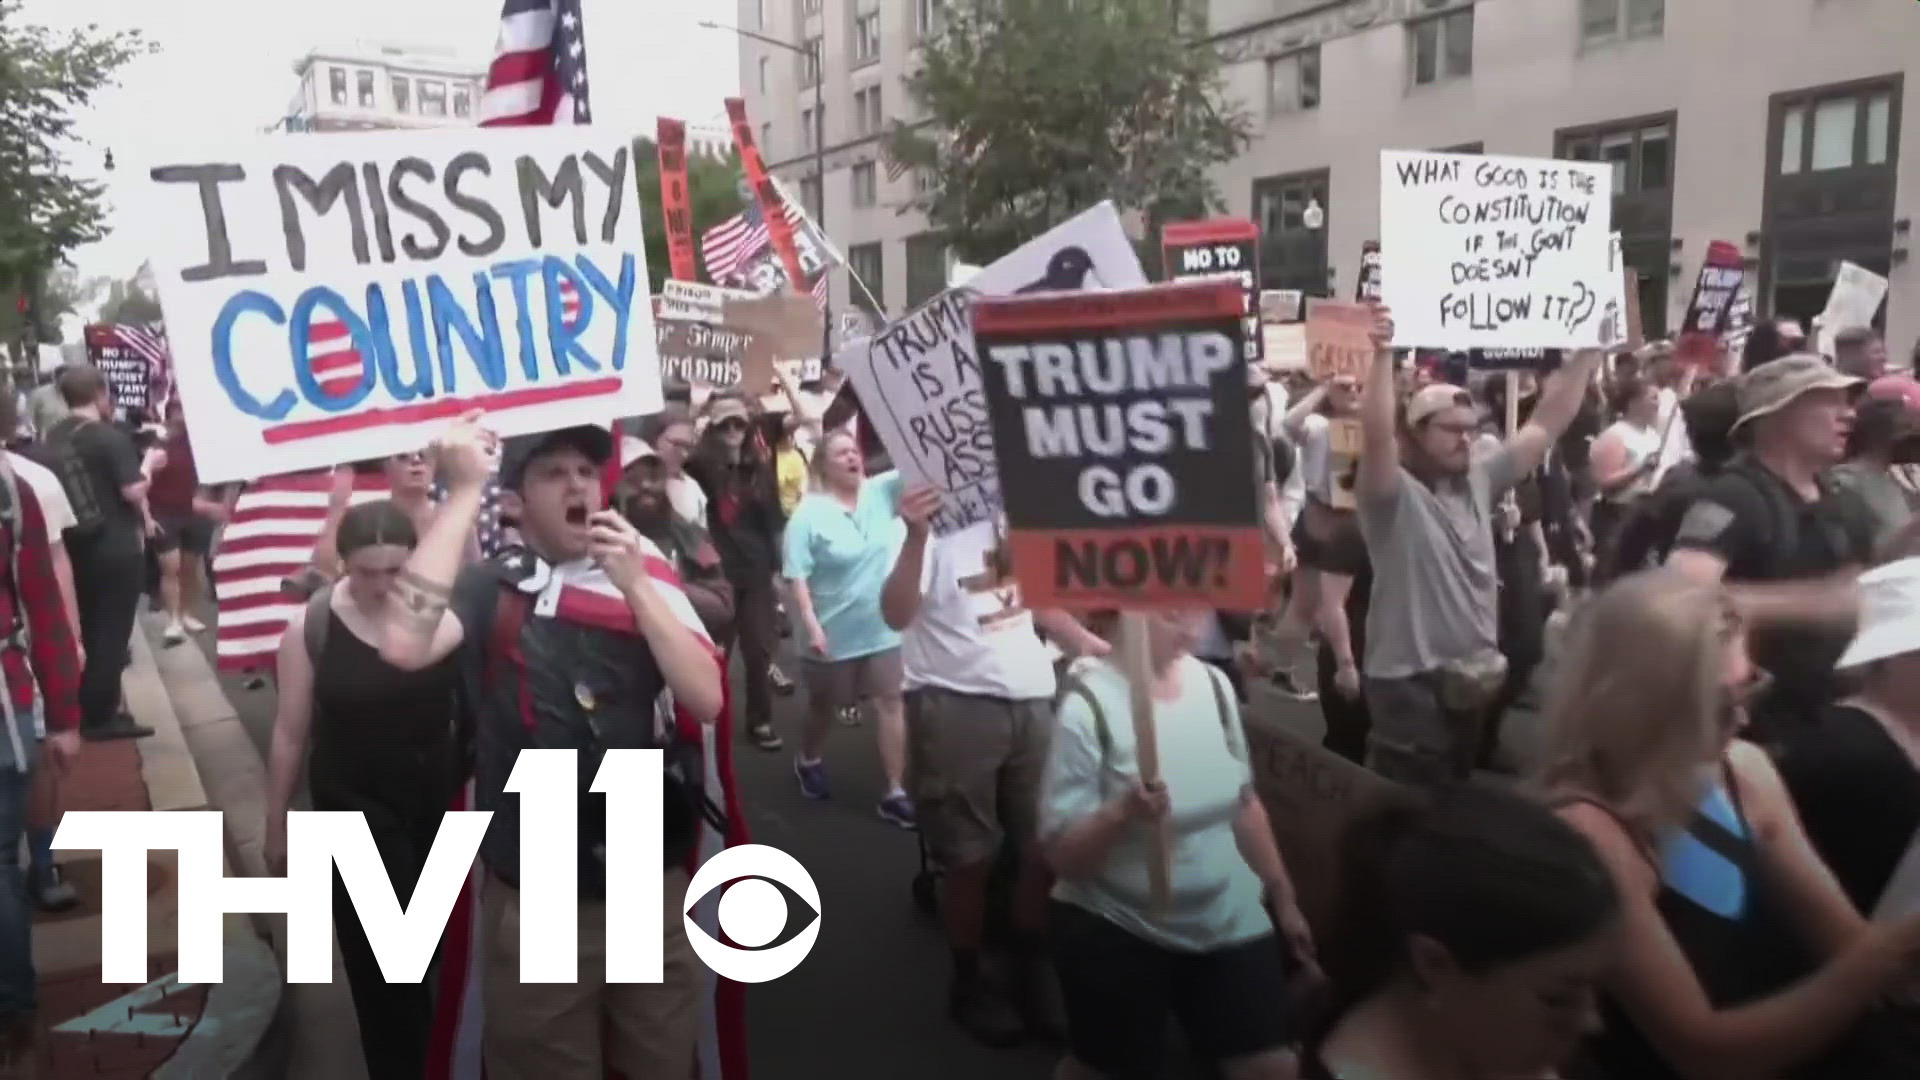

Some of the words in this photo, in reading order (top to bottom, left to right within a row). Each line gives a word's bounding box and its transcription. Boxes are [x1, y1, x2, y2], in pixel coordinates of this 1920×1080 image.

[1397, 159, 1461, 187] WHAT
[1475, 161, 1527, 189] GOOD
[1539, 170, 1559, 189] IS
[1568, 169, 1595, 195] THE
[150, 163, 267, 283] I
[272, 151, 505, 272] MISS
[516, 146, 627, 249] MY
[1439, 194, 1590, 225] CONSTITUTION
[1184, 248, 1212, 270] NO
[1215, 245, 1240, 267] TO
[1465, 234, 1484, 253] IF
[211, 252, 636, 422] COUNTRY
[1440, 292, 1531, 330] FOLLOW
[911, 361, 944, 402] IS
[950, 340, 982, 387] A
[989, 331, 1233, 398] TRUMP
[1022, 398, 1213, 459] MUST
[1078, 463, 1175, 517] GO
[1054, 535, 1229, 588] NOW!
